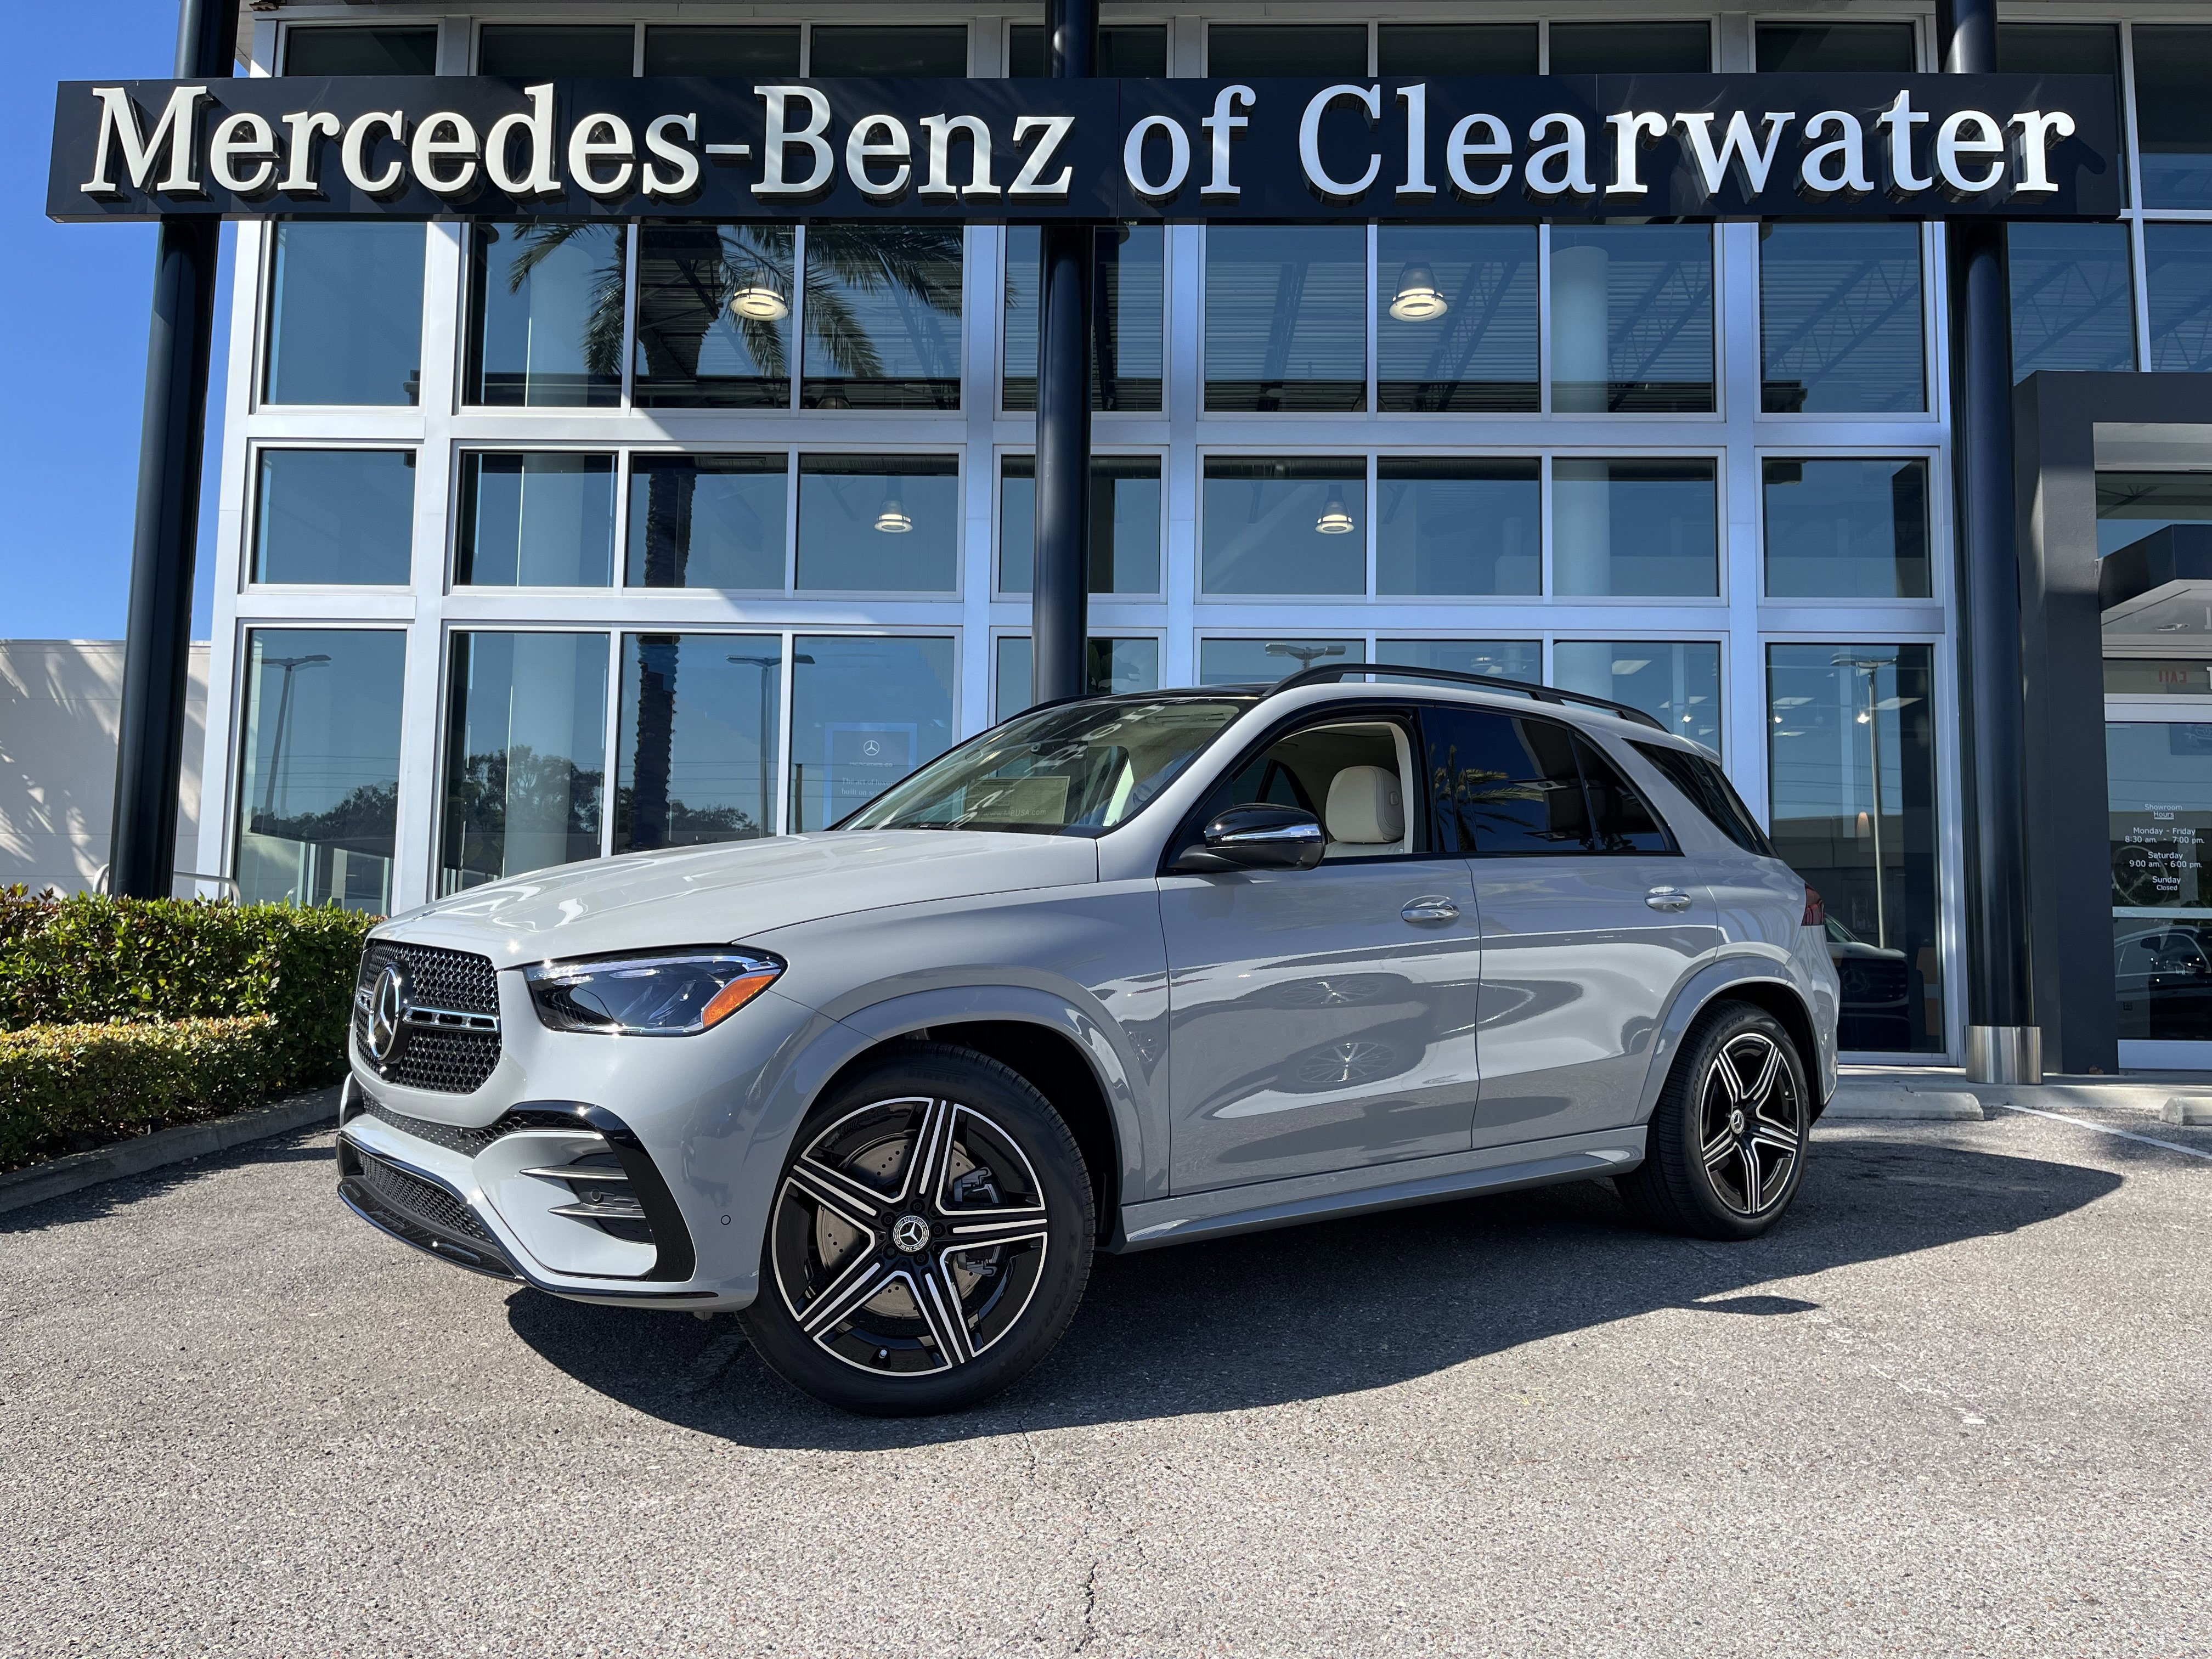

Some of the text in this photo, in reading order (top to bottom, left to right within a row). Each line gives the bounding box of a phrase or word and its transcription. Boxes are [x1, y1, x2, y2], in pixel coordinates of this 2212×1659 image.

[80, 82, 2075, 196] Mercedes-Benz of Clearwater
[2133, 827, 2163, 836] Monday
[2172, 827, 2196, 836] Friday
[2148, 851, 2183, 860] Saturday
[2152, 876, 2181, 884] Sunday
[904, 1216, 926, 1228] MERCEDES
